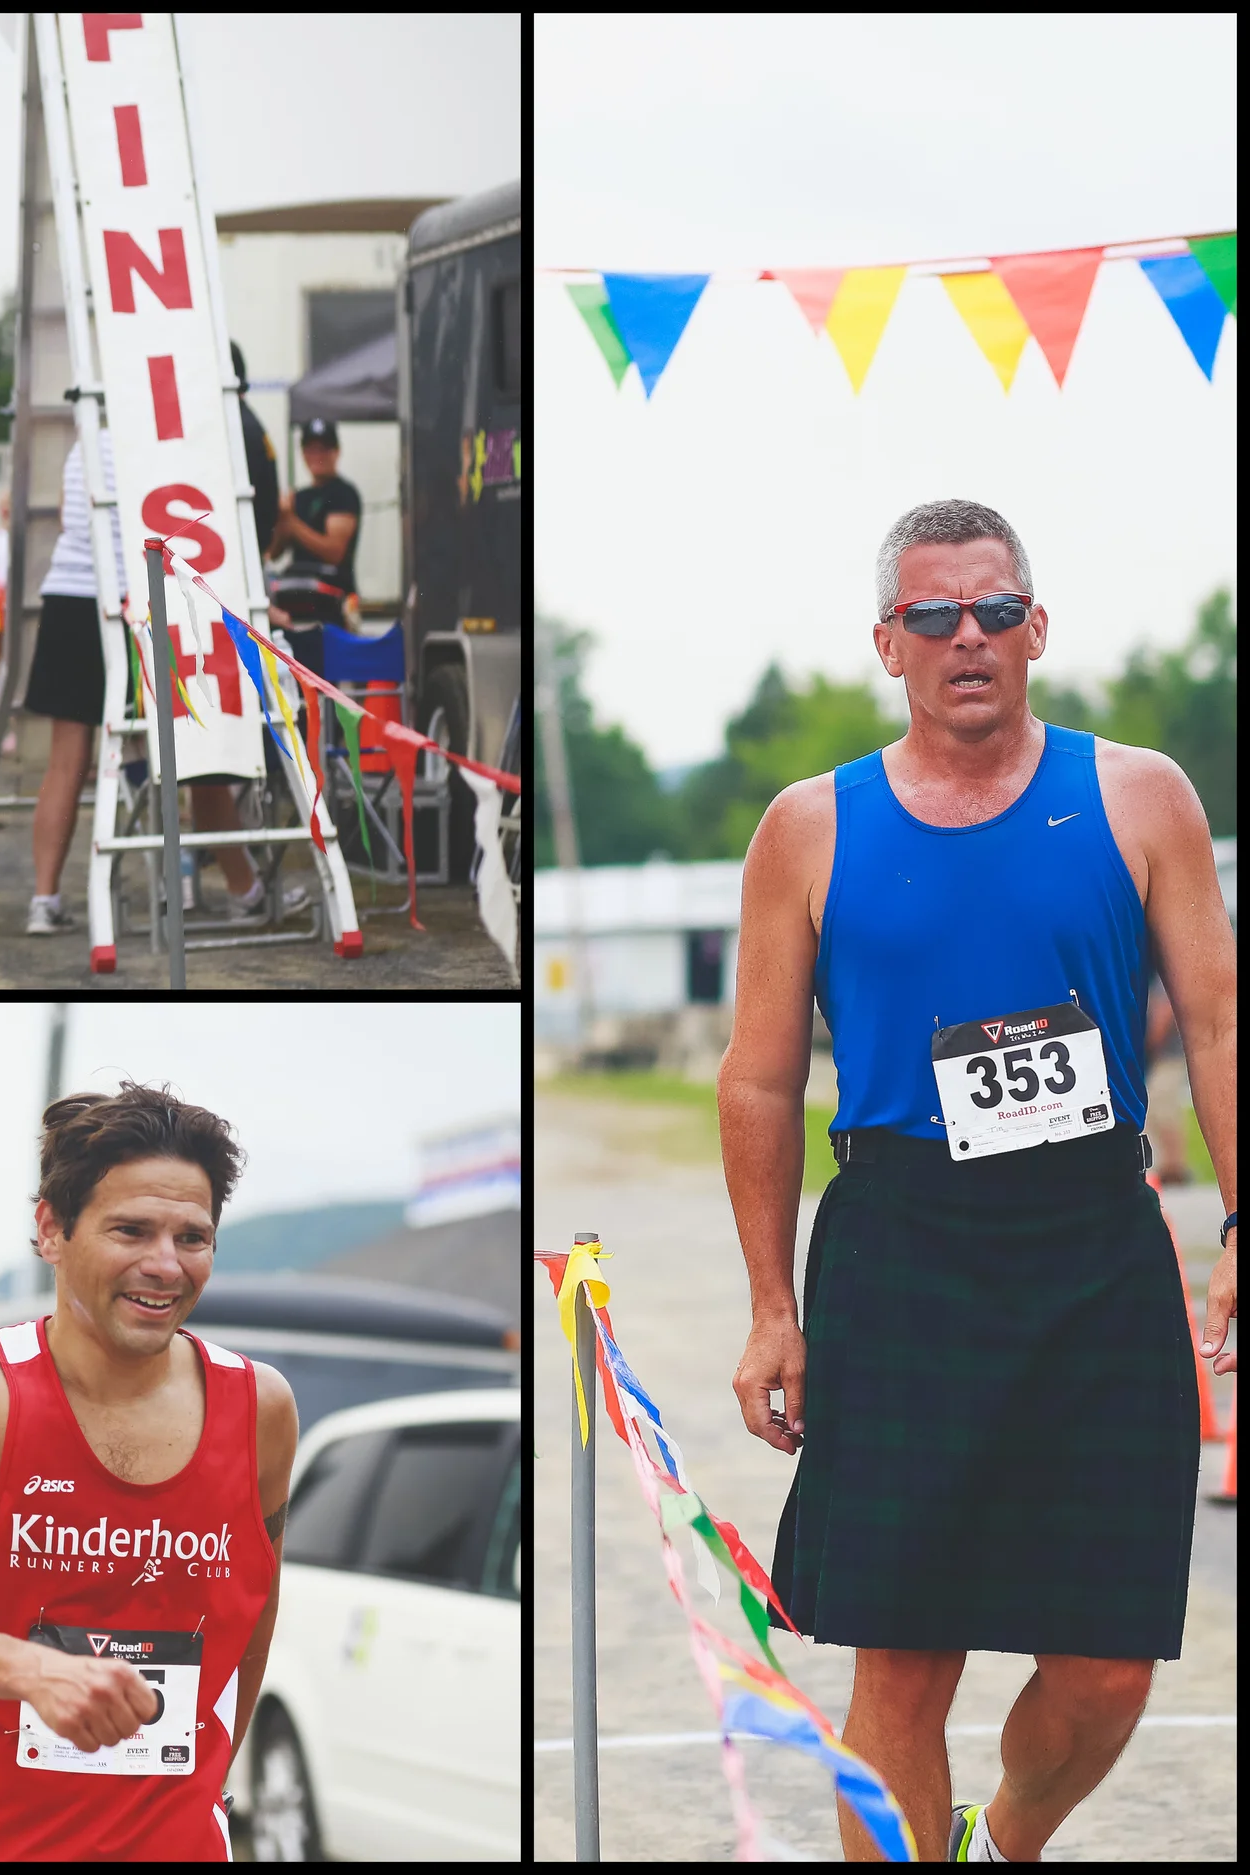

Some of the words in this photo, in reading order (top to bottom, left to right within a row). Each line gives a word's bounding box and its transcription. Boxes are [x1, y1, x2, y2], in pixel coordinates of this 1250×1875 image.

[81, 14, 243, 718] FINISH
[1004, 1018, 1049, 1036] RoadID
[966, 1041, 1076, 1109] 353
[997, 1101, 1063, 1120] RoadID.com
[1049, 1114, 1071, 1124] EVENT
[10, 1513, 232, 1561] Kinderhook
[9, 1554, 114, 1574] RUNNERS
[187, 1562, 230, 1578] CLUB
[109, 1641, 154, 1653] RoadID
